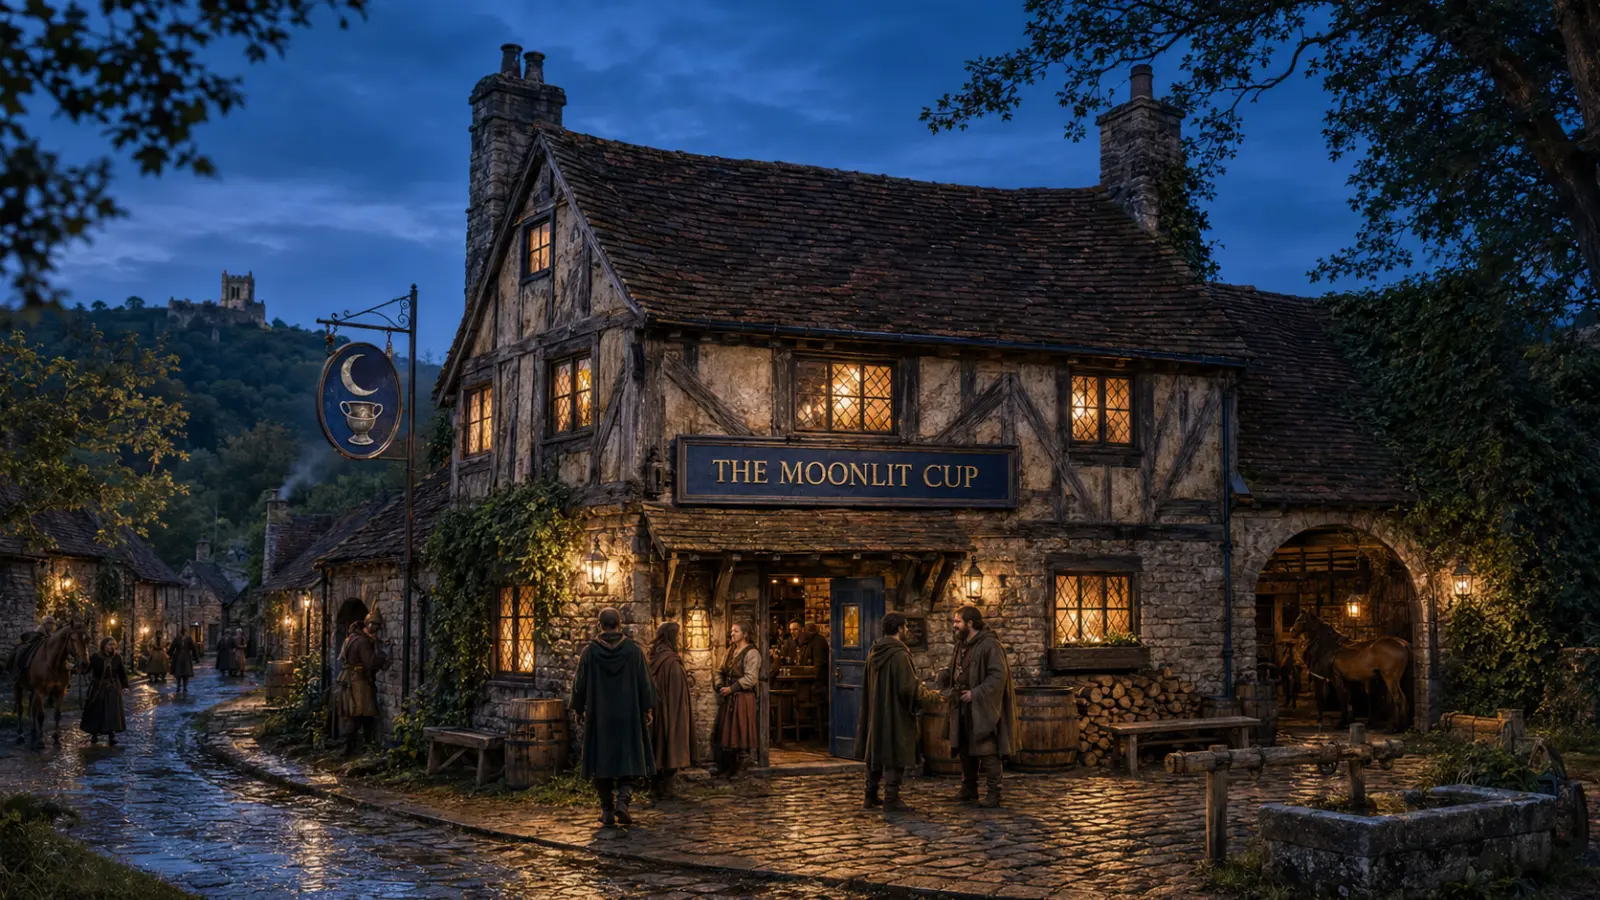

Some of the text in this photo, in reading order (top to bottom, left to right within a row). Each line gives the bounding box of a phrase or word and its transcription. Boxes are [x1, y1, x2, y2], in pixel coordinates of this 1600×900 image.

[712, 459, 979, 488] THE MOONLIT CUP
